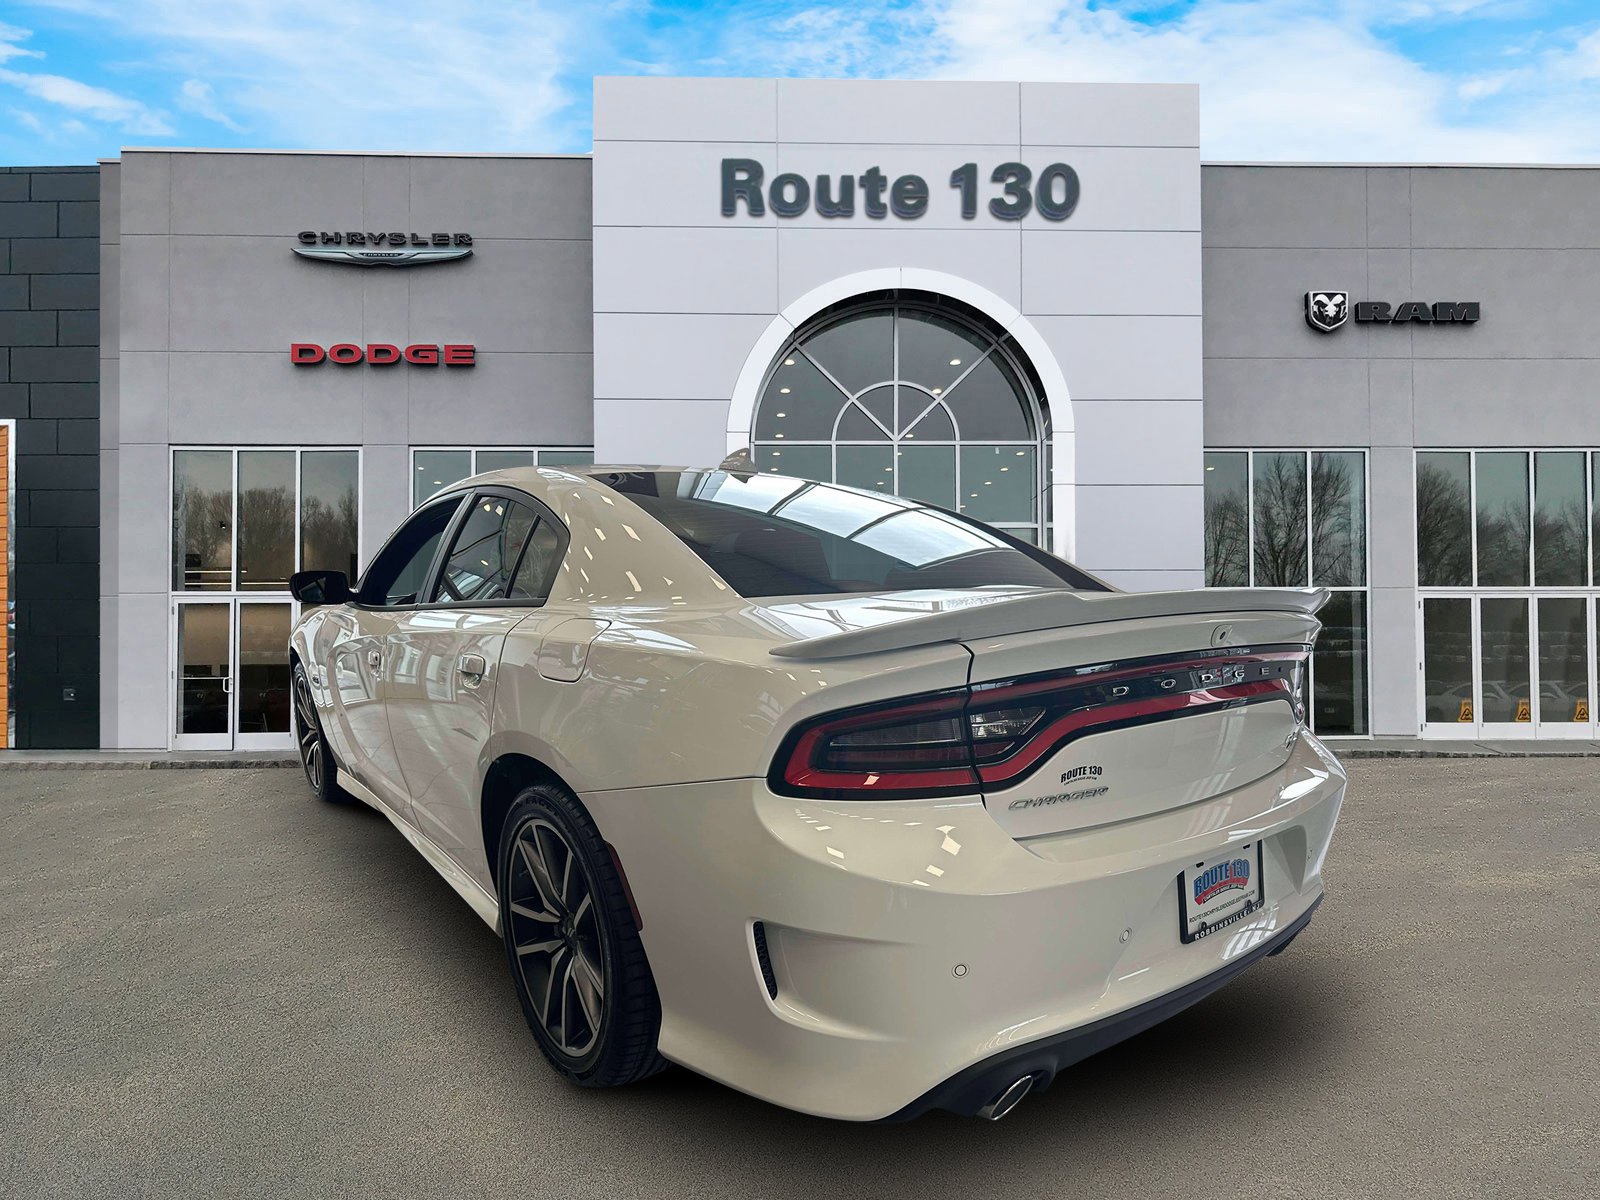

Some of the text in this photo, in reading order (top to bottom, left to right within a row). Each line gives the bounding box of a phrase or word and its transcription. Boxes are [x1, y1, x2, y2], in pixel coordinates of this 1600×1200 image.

[720, 158, 1081, 220] Route 130
[297, 231, 473, 245] CHRYSLER
[1354, 301, 1480, 324] RAM
[290, 343, 477, 367] DODGE
[1112, 667, 1270, 697] DODGE
[1060, 766, 1088, 783] ROUTE
[1088, 765, 1103, 776] 130
[1008, 786, 1109, 811] CHARGER
[1194, 859, 1251, 897] ROUTE 130
